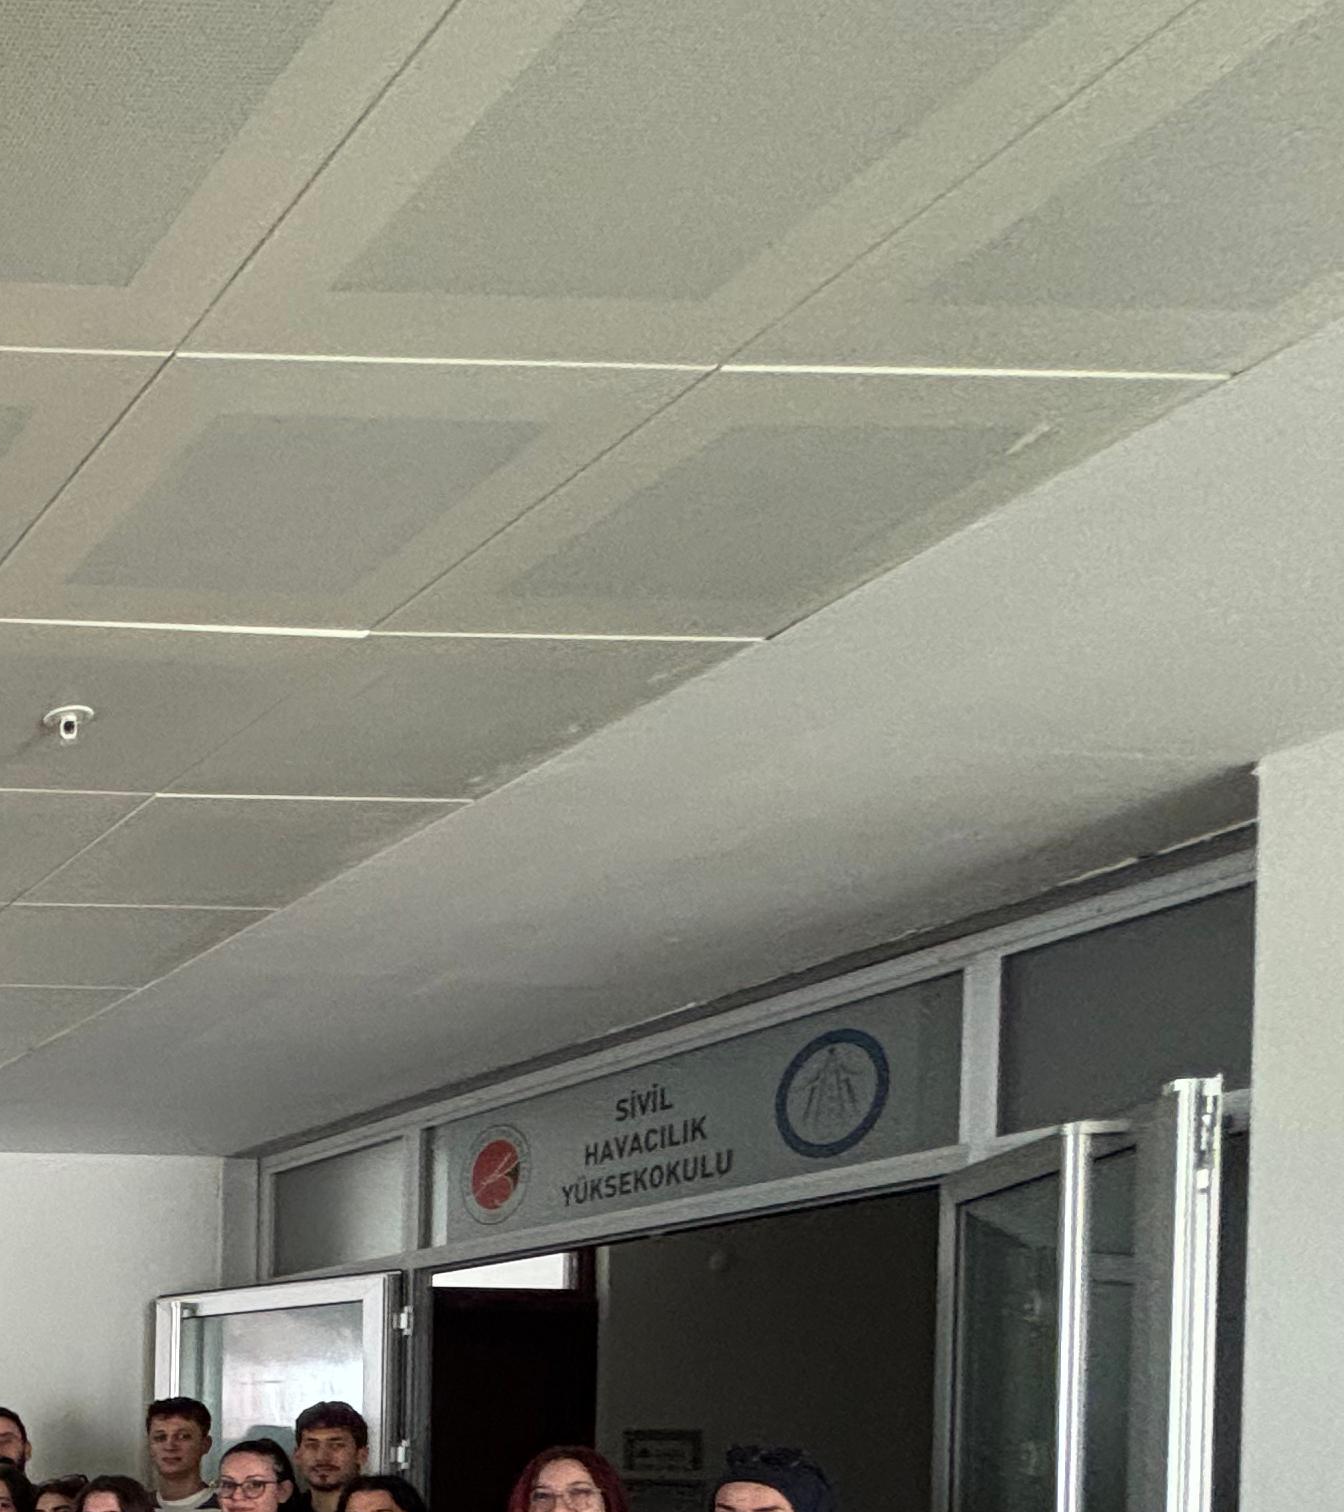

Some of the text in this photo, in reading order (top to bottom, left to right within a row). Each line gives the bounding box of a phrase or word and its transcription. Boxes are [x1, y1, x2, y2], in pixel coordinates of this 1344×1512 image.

[615, 1083, 673, 1122] SİVİL
[585, 1116, 707, 1166] HAVACILIK
[561, 1150, 734, 1206] YÜKSEKOKULU
